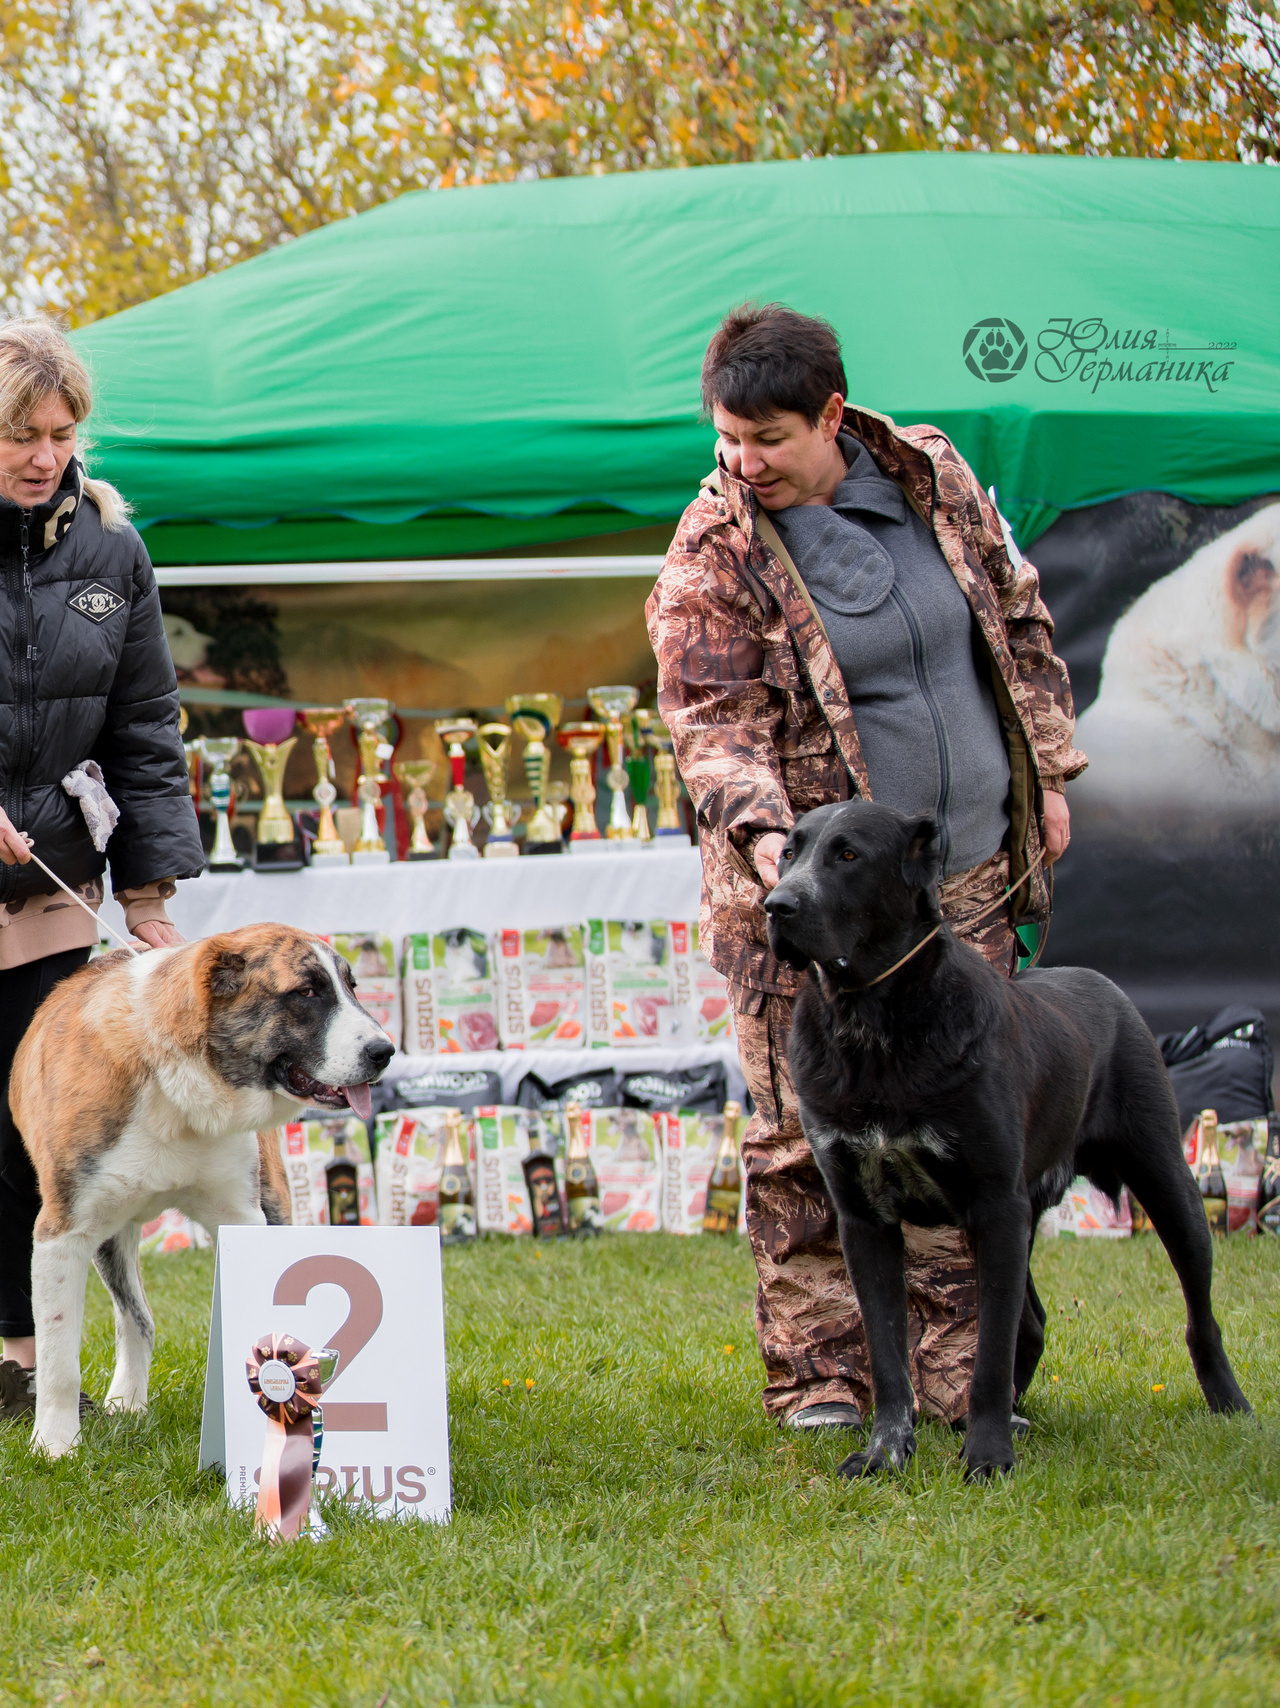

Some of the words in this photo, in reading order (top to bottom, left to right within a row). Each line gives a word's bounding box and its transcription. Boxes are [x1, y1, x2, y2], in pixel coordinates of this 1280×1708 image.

[415, 978, 435, 1050] SIRIUS
[291, 1162, 314, 1226] IRIUS
[272, 1254, 389, 1432] 2
